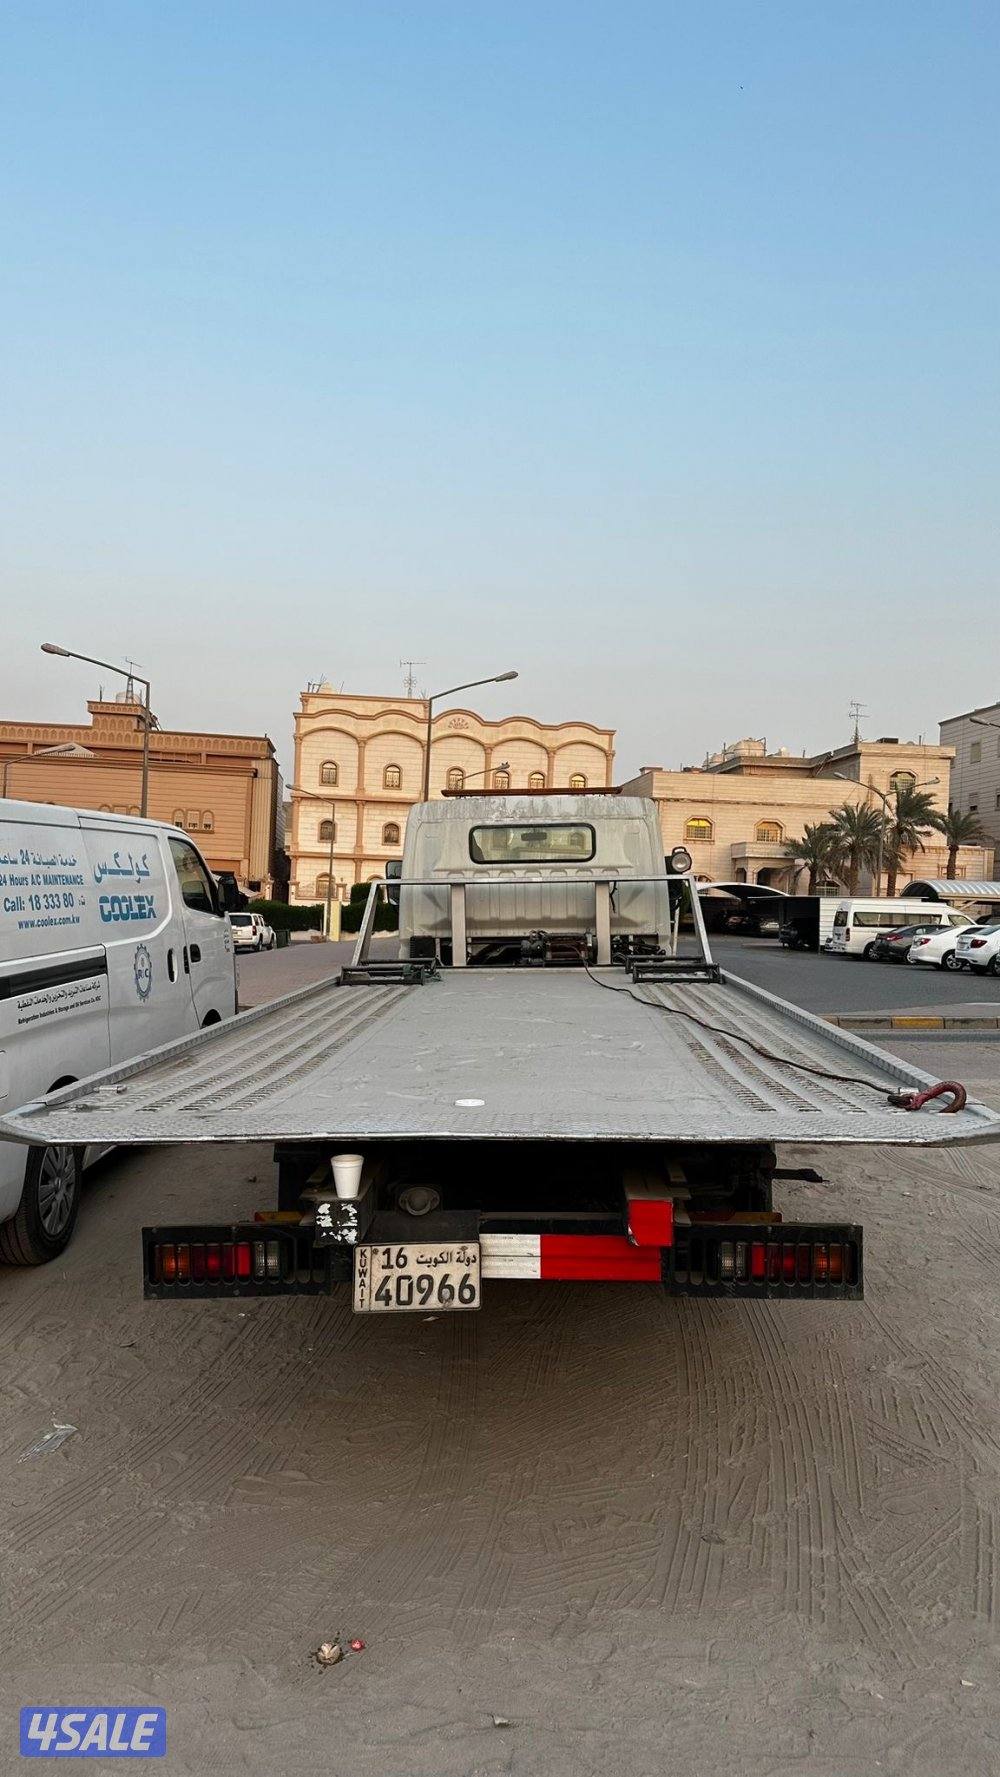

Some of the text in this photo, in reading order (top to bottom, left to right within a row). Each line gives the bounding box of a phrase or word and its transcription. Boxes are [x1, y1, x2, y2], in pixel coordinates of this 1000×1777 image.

[20, 849, 30, 865] 24
[9, 873, 29, 886] Hours
[42, 874, 84, 885] MAINTENANCE
[4, 896, 25, 912] Call:
[28, 894, 41, 911] 18
[43, 893, 61, 910] 333
[63, 892, 74, 908] 80
[99, 895, 156, 922] COOLEX
[381, 1247, 477, 1270] 16 الكويت دولة
[358, 1249, 368, 1308] KUWAIT
[375, 1273, 476, 1307] 40966
